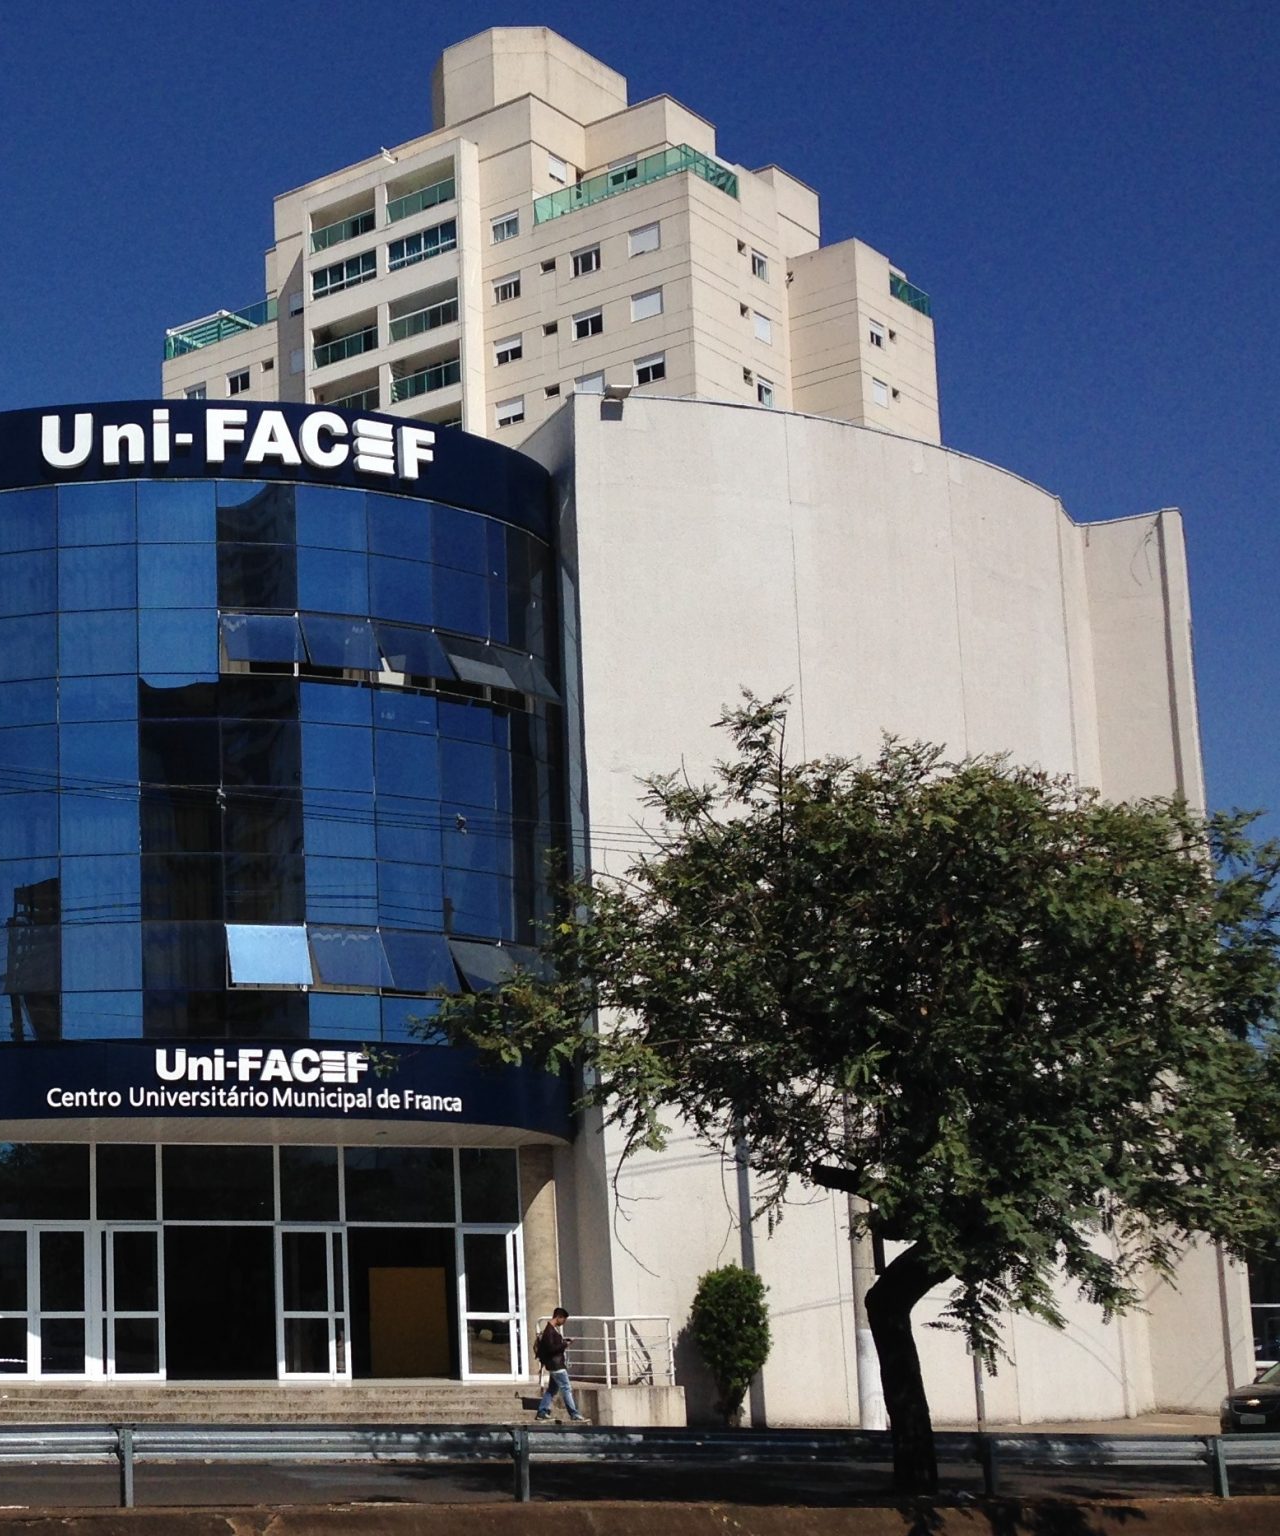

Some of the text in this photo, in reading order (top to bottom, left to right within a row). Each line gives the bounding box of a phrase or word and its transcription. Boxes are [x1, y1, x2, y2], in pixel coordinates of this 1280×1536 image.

[40, 408, 435, 480] Uni-FACEF
[155, 1048, 370, 1084] Uni-FACEF
[46, 1085, 463, 1113] Centro Universitário Municipal de Franca
